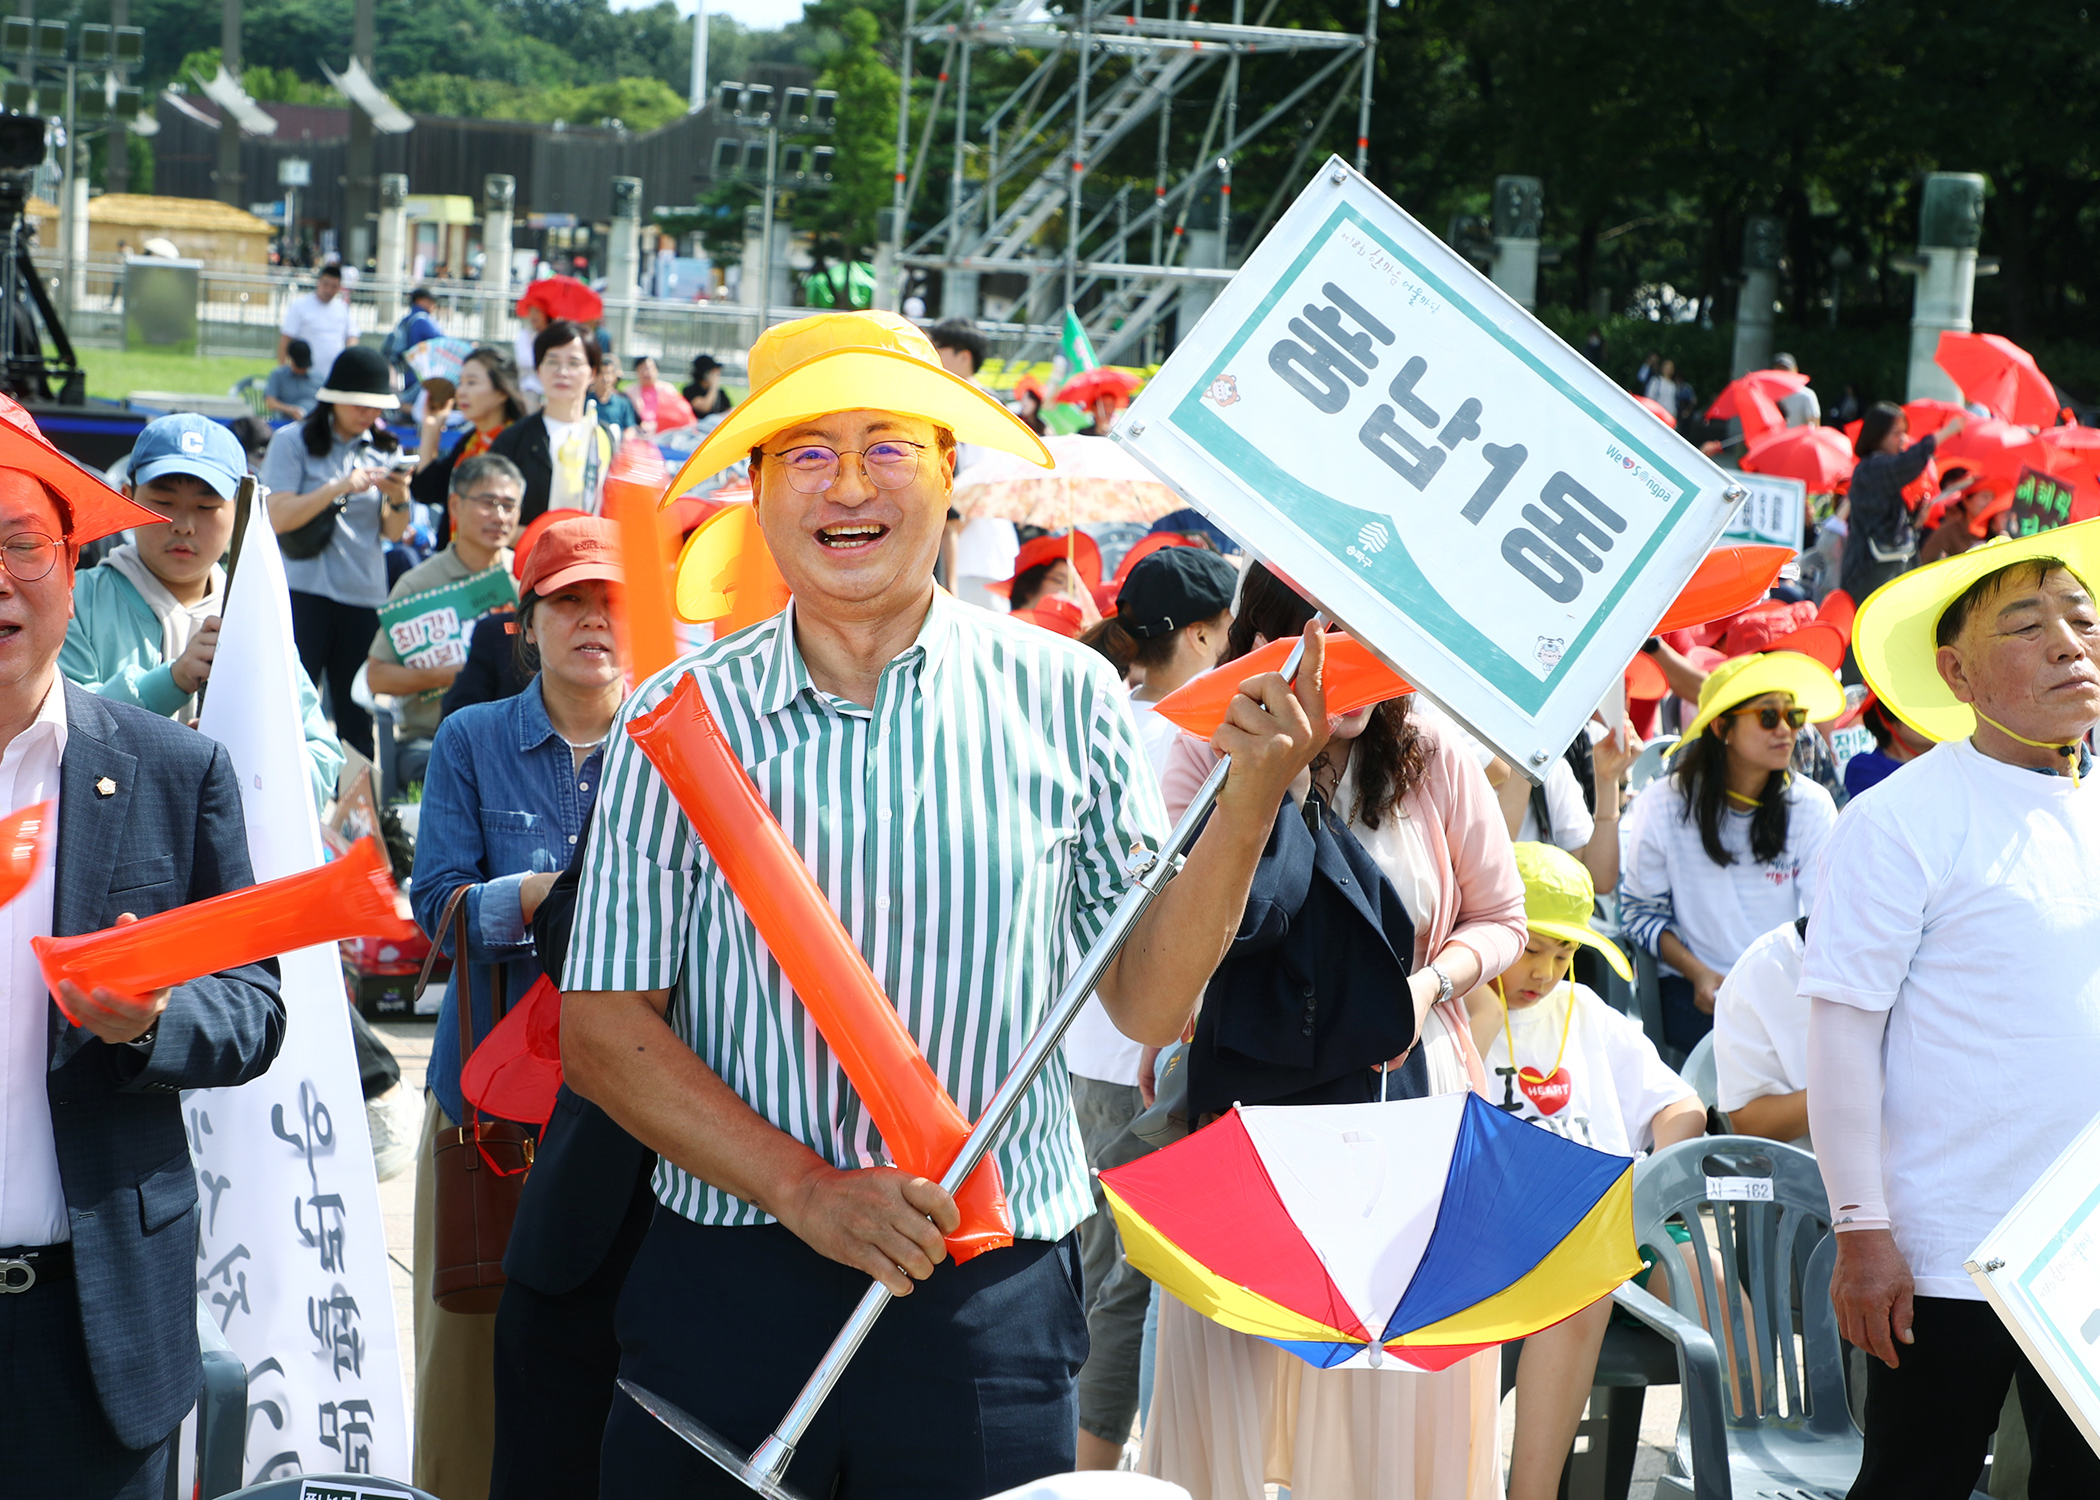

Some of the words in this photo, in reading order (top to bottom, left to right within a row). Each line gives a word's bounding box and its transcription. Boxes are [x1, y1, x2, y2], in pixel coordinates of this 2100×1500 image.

[1402, 281, 1441, 315] 어울마당
[181, 431, 204, 453] C
[1268, 281, 1628, 604] 풍납1동
[1606, 444, 1623, 464] We
[1346, 545, 1373, 568] 송파구
[1527, 1084, 1569, 1097] HEART
